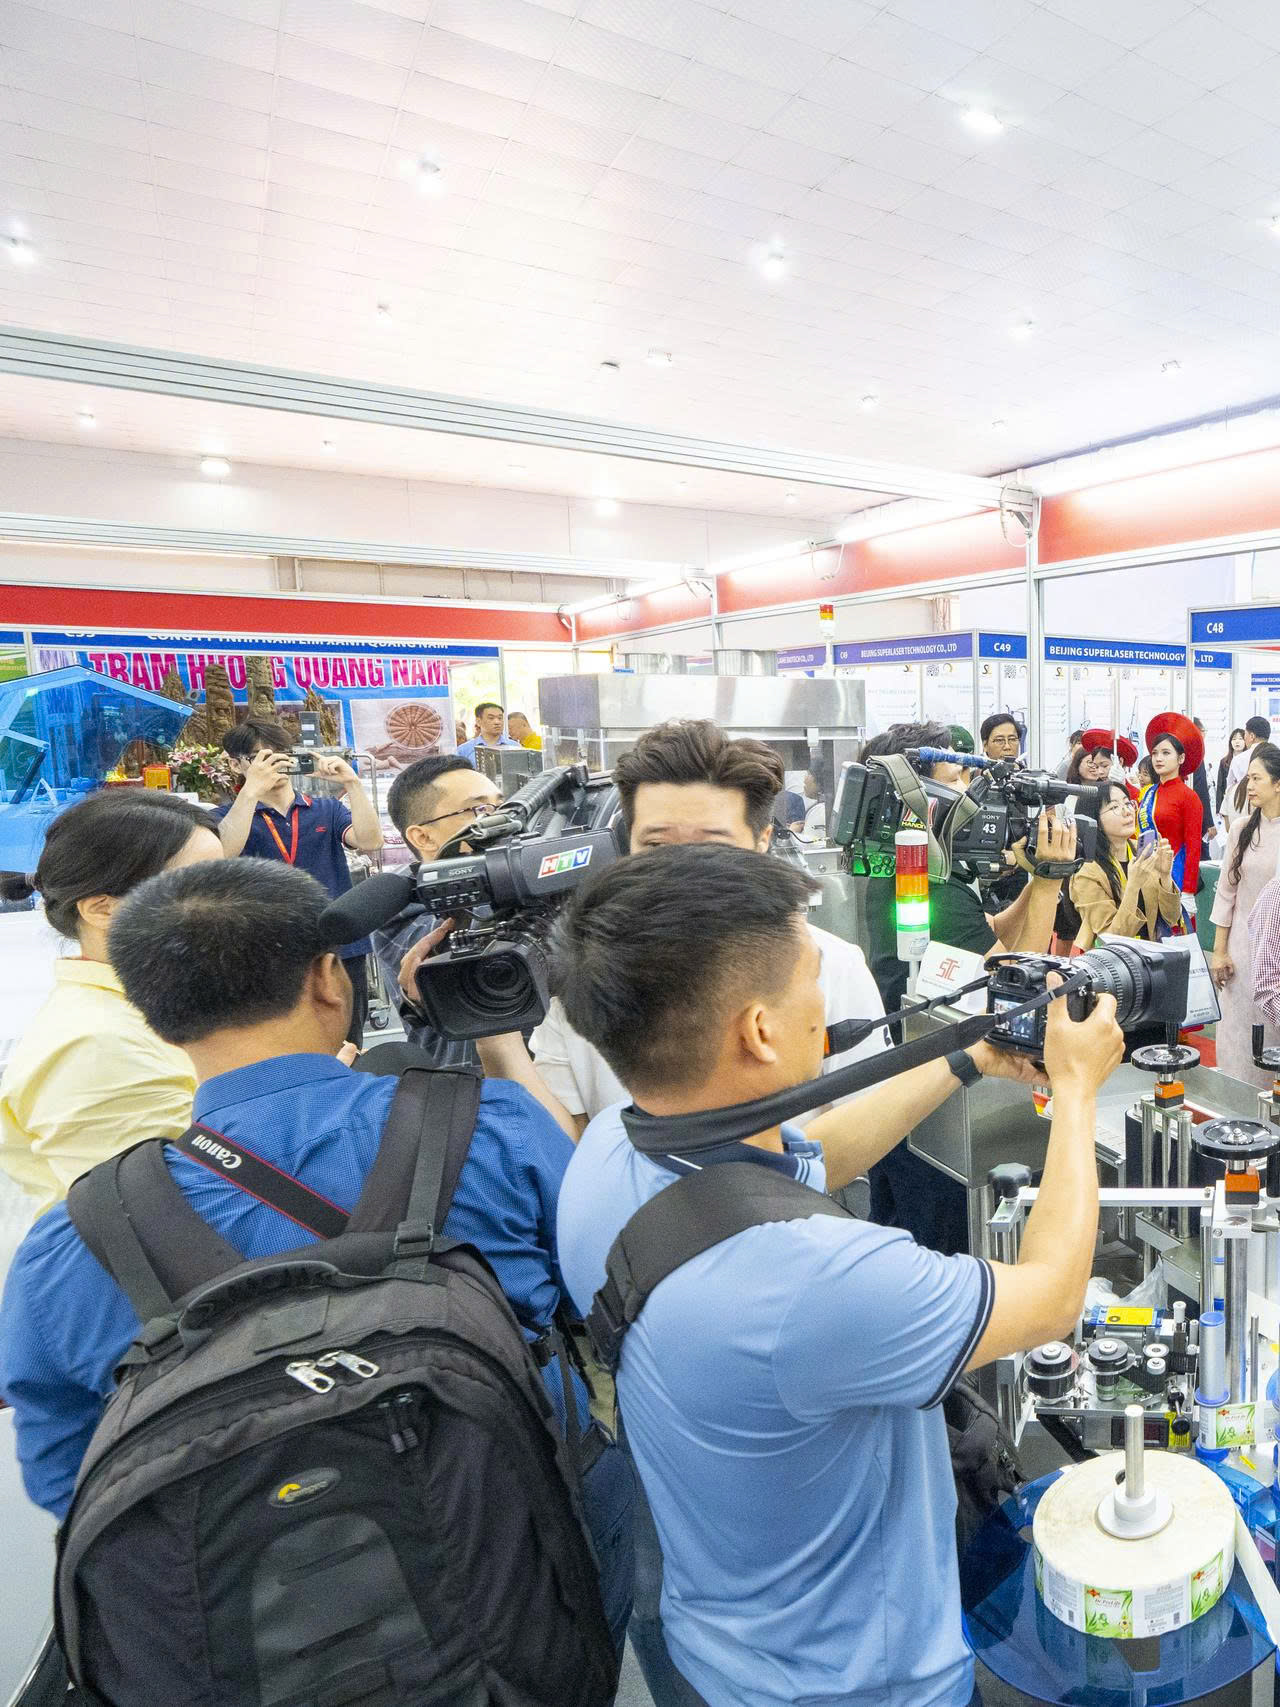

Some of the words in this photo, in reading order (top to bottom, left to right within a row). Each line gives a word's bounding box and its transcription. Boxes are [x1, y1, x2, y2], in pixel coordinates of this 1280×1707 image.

[1206, 622, 1224, 634] C48
[947, 643, 958, 653] LTD
[993, 641, 1011, 653] C49
[1049, 645, 1083, 656] BEIJING
[1083, 647, 1136, 659] SUPERLASER
[1135, 650, 1185, 661] TECHNOLOGY
[1200, 654, 1214, 663] LTD
[982, 823, 997, 834] 43
[542, 850, 590, 874] HTV
[448, 866, 475, 876] SONY
[191, 1134, 242, 1169] Canon
